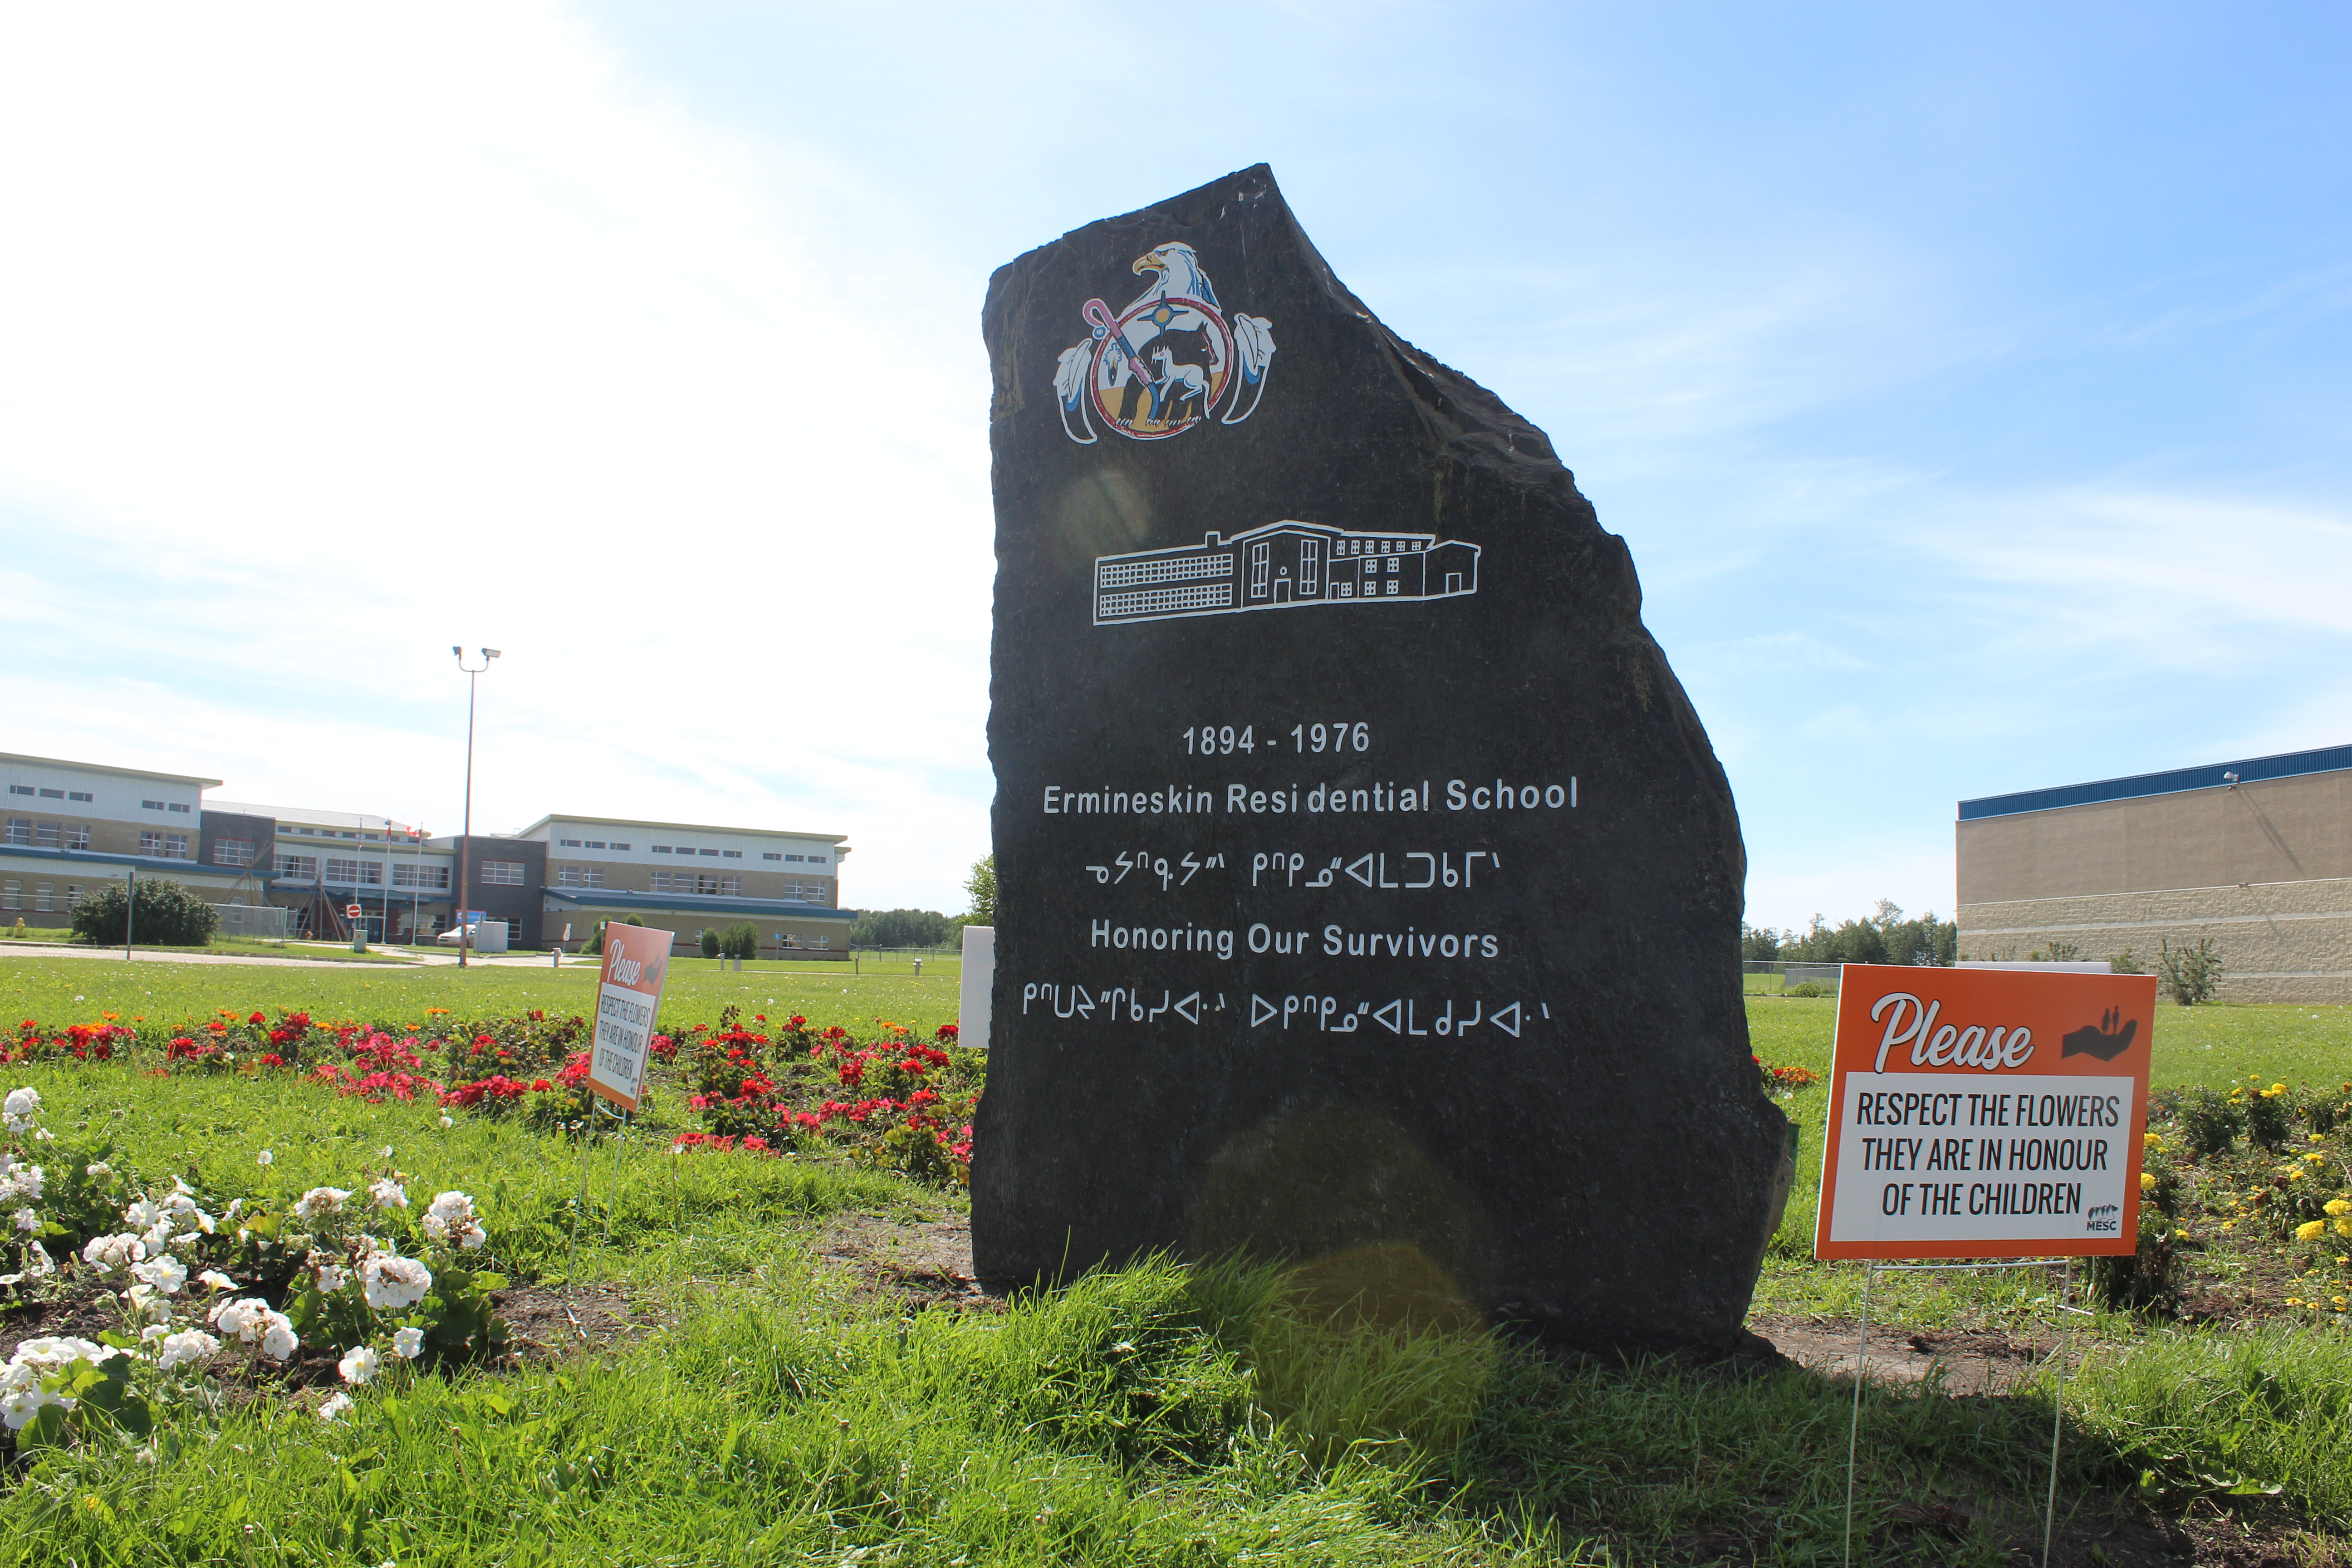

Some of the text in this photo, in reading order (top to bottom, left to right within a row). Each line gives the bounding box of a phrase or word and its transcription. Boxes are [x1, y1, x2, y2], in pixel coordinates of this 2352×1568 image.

[1183, 725, 1255, 755] 1894
[1291, 722, 1369, 753] 1976
[1044, 776, 1577, 813] Ermineskin Residential School
[1092, 919, 1498, 960] Honoring Our Survivors
[607, 937, 641, 986] Please
[600, 994, 650, 1027] RESPECT THE FLOWERS
[599, 1020, 643, 1054] THEY ARE IN HONOUR
[1871, 992, 2034, 1074] Please
[599, 1048, 634, 1080] OF THE CHILDREN
[1857, 1092, 2120, 1127] RESPECT THE FLOWERS
[1862, 1138, 2107, 1171] THEY ARE IN HONOUR
[1882, 1183, 2081, 1216] OF THE CHILDREN
[2087, 1220, 2117, 1231] MESC
